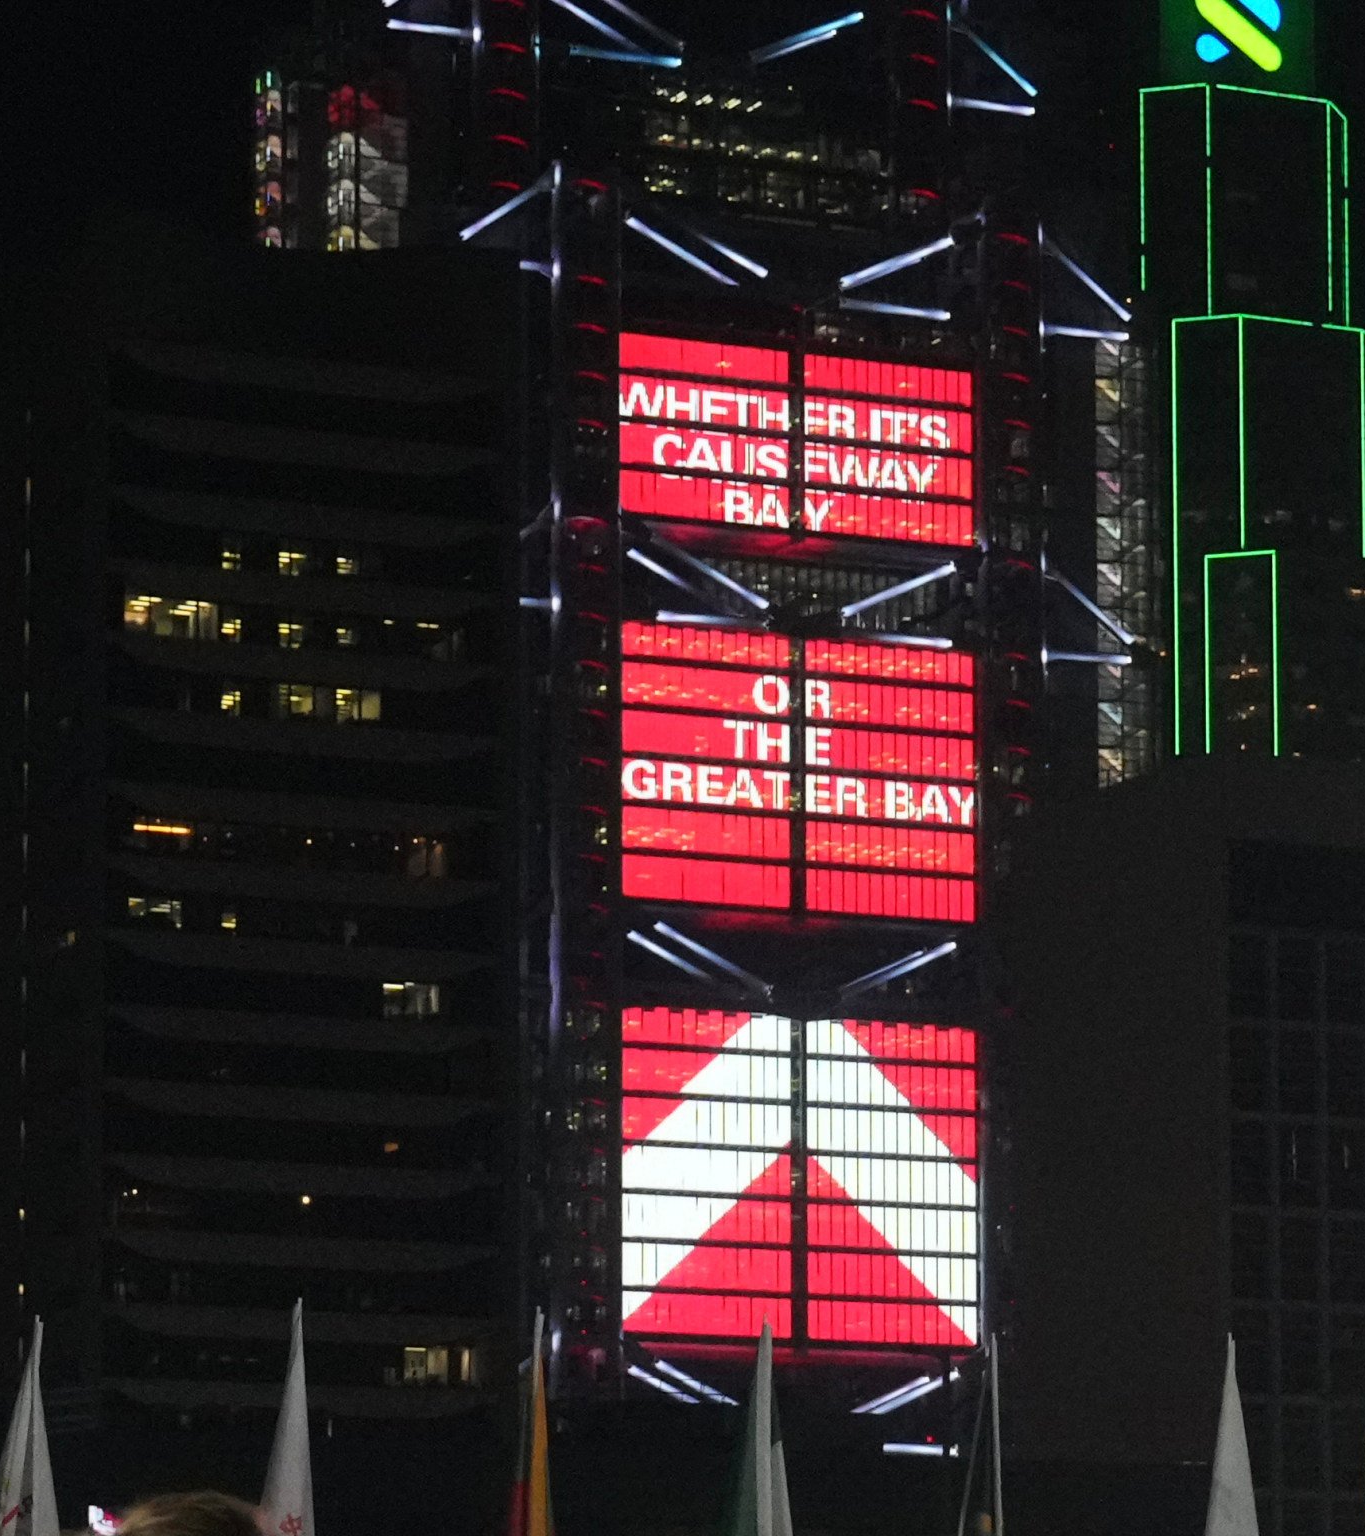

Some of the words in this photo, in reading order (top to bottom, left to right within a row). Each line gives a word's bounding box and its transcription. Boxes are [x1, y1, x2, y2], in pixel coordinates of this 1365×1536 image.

[619, 382, 856, 444] WHETHER
[870, 409, 950, 457] IT'S
[652, 433, 938, 505] CAUSEWAY
[724, 488, 834, 532] BAY
[752, 674, 832, 719] OR
[723, 719, 832, 767] THE
[621, 759, 869, 818] GREATER
[885, 780, 975, 825] BAY
